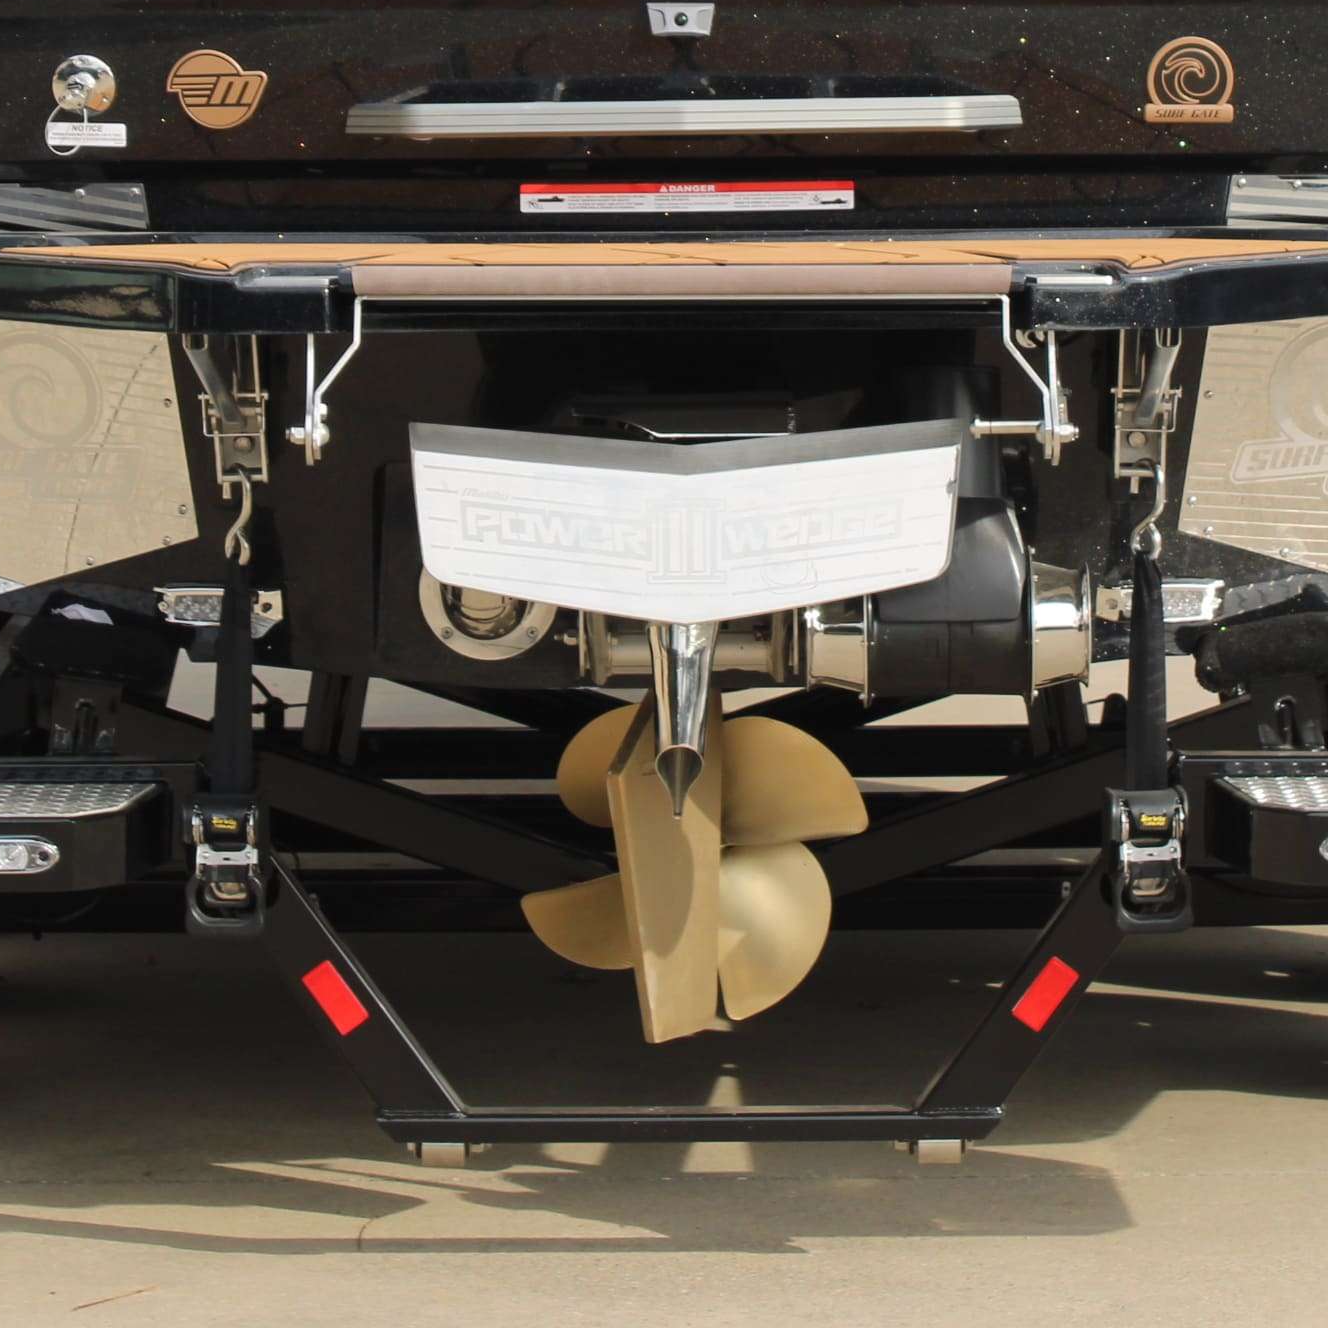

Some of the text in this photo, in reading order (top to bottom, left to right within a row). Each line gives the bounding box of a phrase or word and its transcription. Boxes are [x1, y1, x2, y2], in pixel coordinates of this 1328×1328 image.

[1154, 108, 1222, 119] SURF GATE
[668, 184, 716, 193] DANGER
